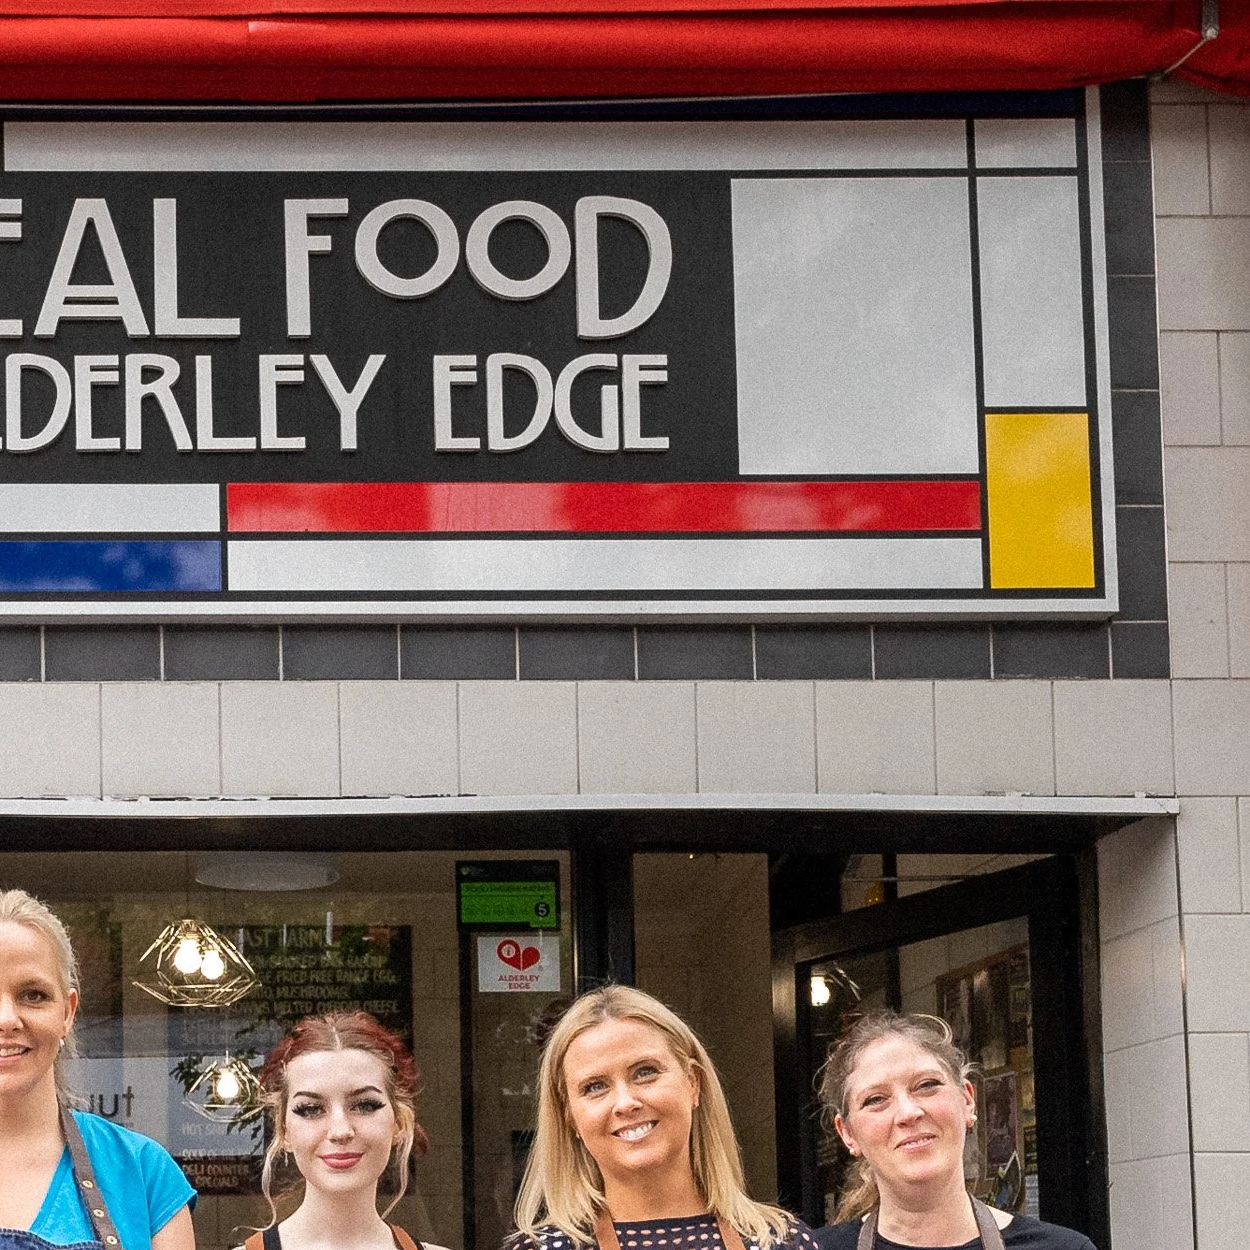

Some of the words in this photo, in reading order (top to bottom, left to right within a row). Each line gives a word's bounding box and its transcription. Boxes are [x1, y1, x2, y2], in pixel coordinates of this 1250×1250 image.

[283, 195, 672, 340] FOOD
[433, 353, 671, 453] EDGE
[538, 904, 548, 916] 5
[497, 974, 540, 982] ALDERLEY
[508, 982, 531, 990] EDGE
